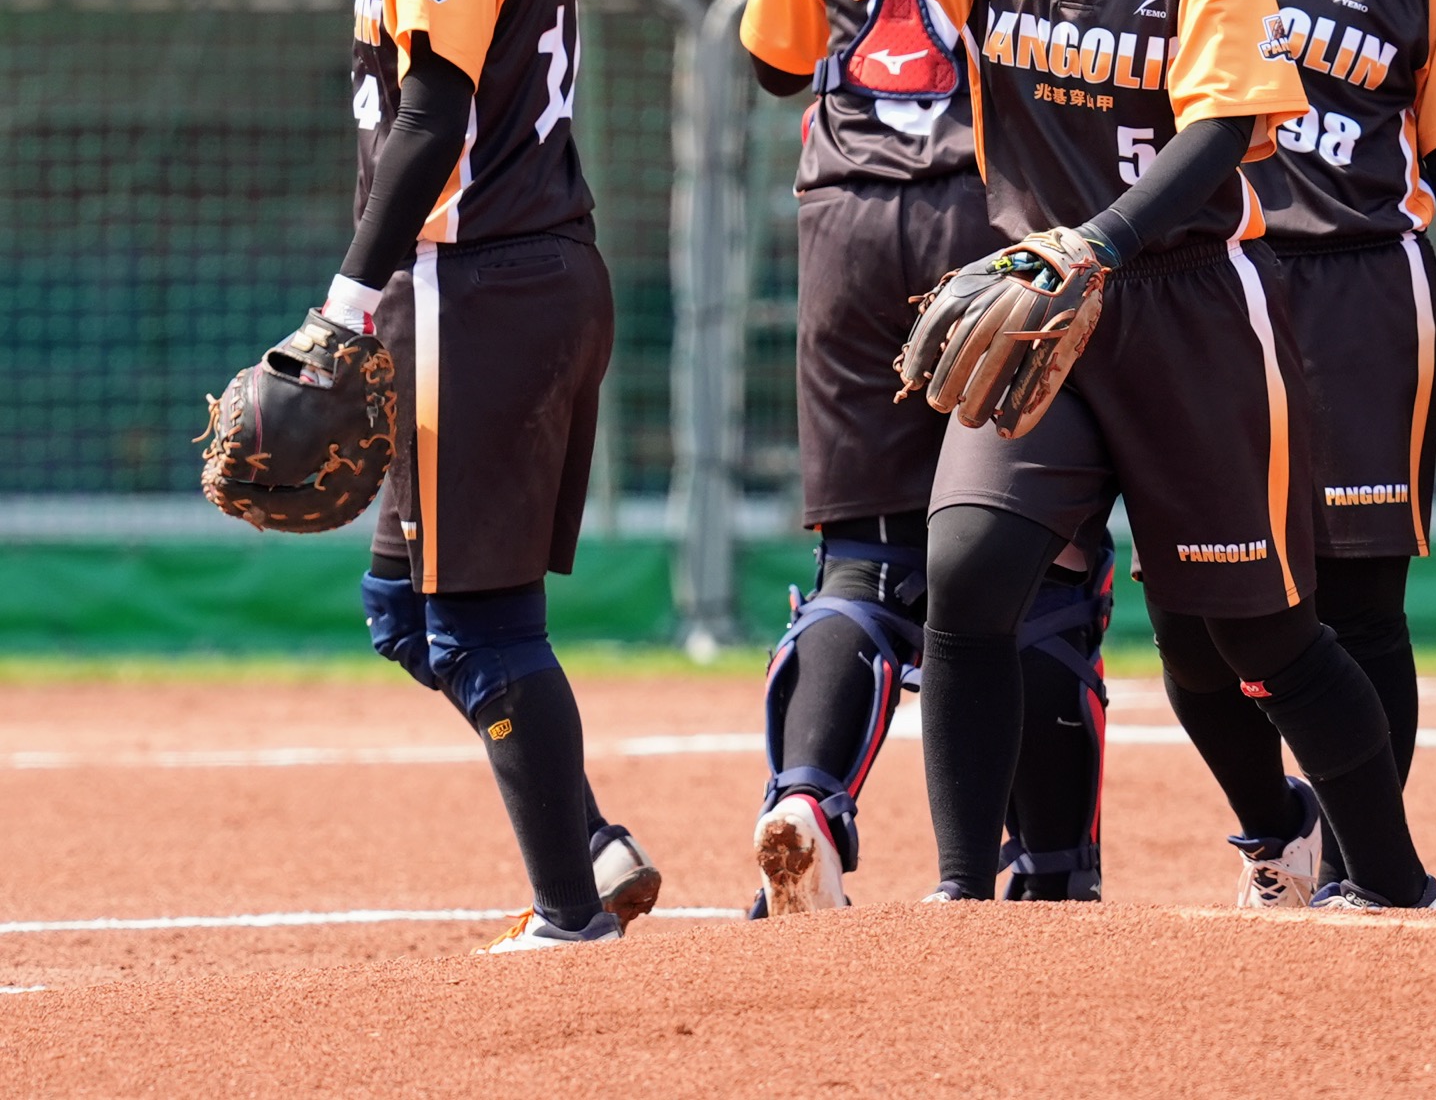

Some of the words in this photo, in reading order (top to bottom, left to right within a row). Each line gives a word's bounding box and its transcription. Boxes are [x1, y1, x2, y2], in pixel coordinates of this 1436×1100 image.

[1139, 7, 1167, 19] YEMO
[1341, 0, 1368, 13] YEMO
[1277, 6, 1398, 91] OLIN
[1277, 104, 1362, 167] 98
[1116, 125, 1157, 185] 5
[1325, 483, 1408, 506] PANGOLIN
[1177, 539, 1268, 564] PANGOLIN
